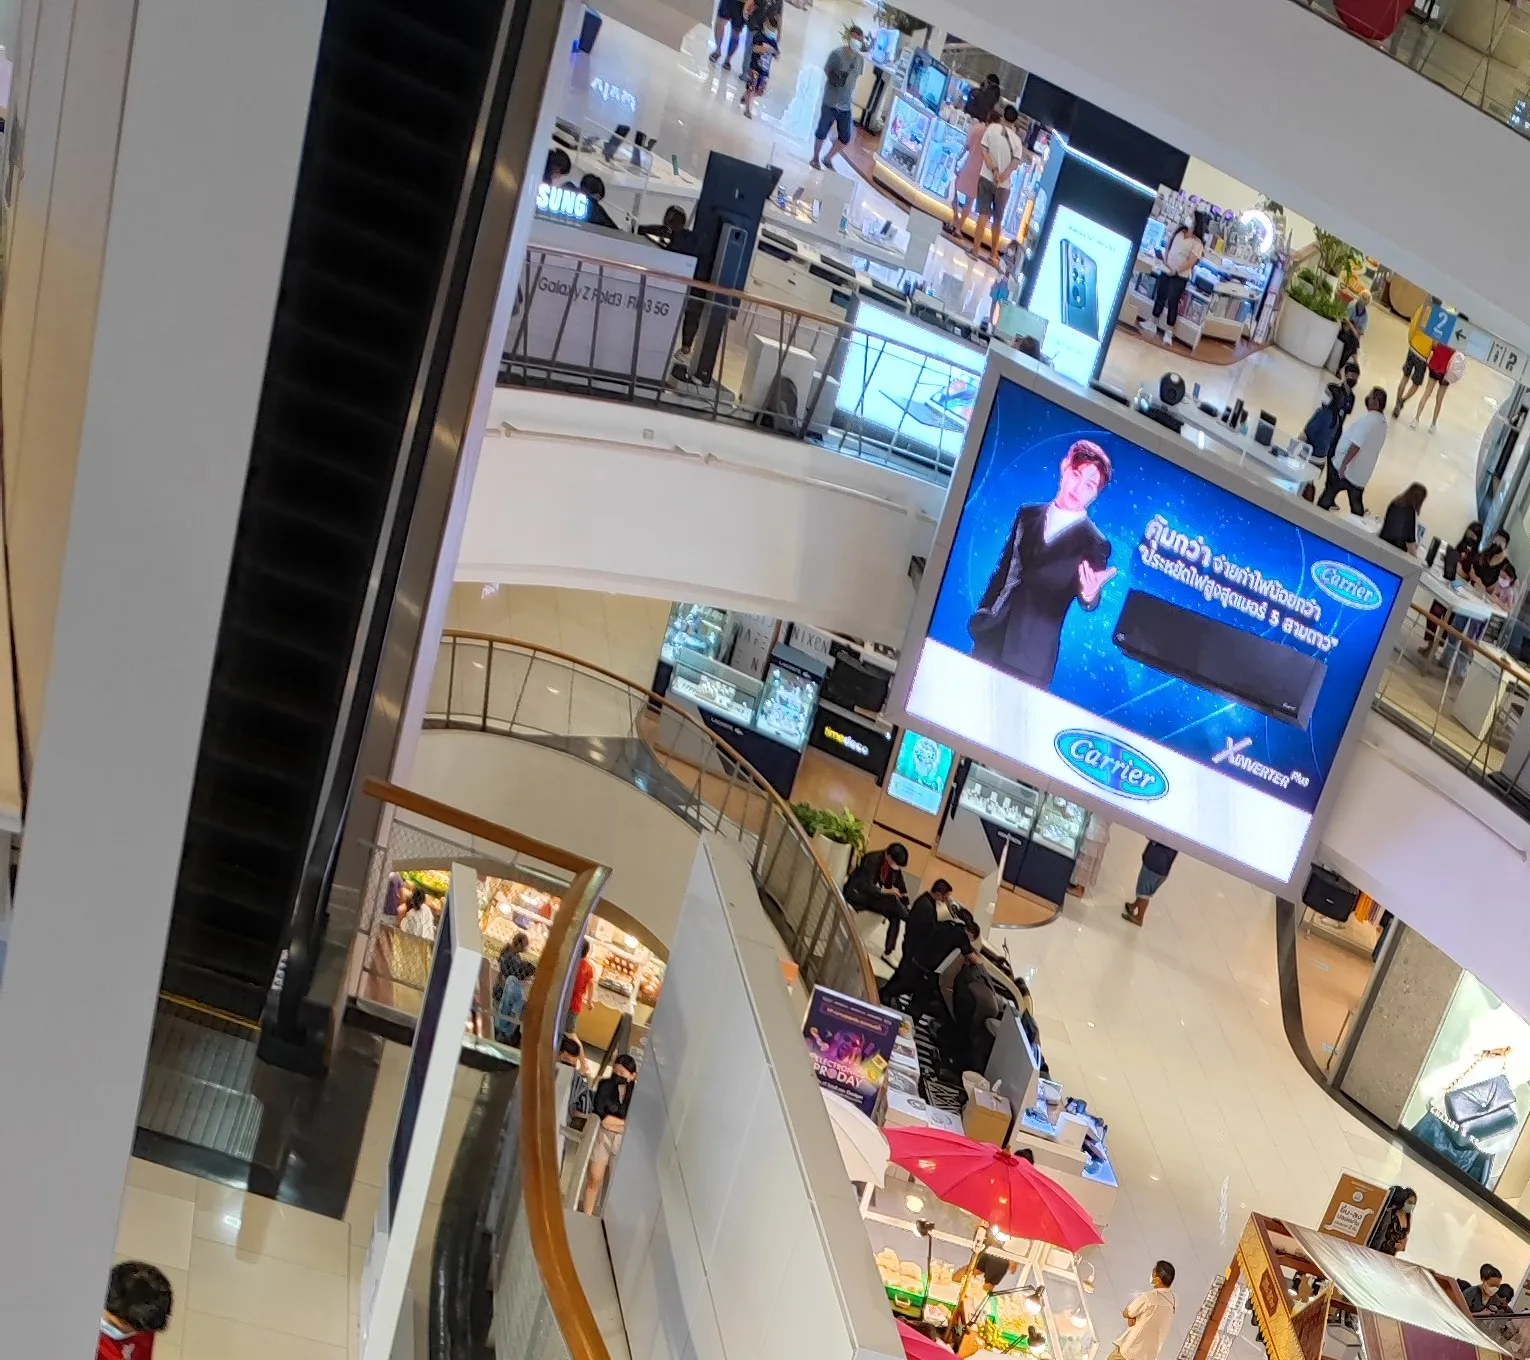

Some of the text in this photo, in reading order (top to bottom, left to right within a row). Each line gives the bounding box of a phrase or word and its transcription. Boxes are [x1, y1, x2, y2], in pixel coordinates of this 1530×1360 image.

[538, 276, 581, 302] Galaxy
[1433, 311, 1449, 335] 2
[1143, 513, 1212, 567] คุ้มกว่า
[1320, 566, 1374, 604] Carrier
[1268, 607, 1281, 628] 5
[790, 625, 832, 656] NIXON
[1069, 737, 1157, 790] Carrier
